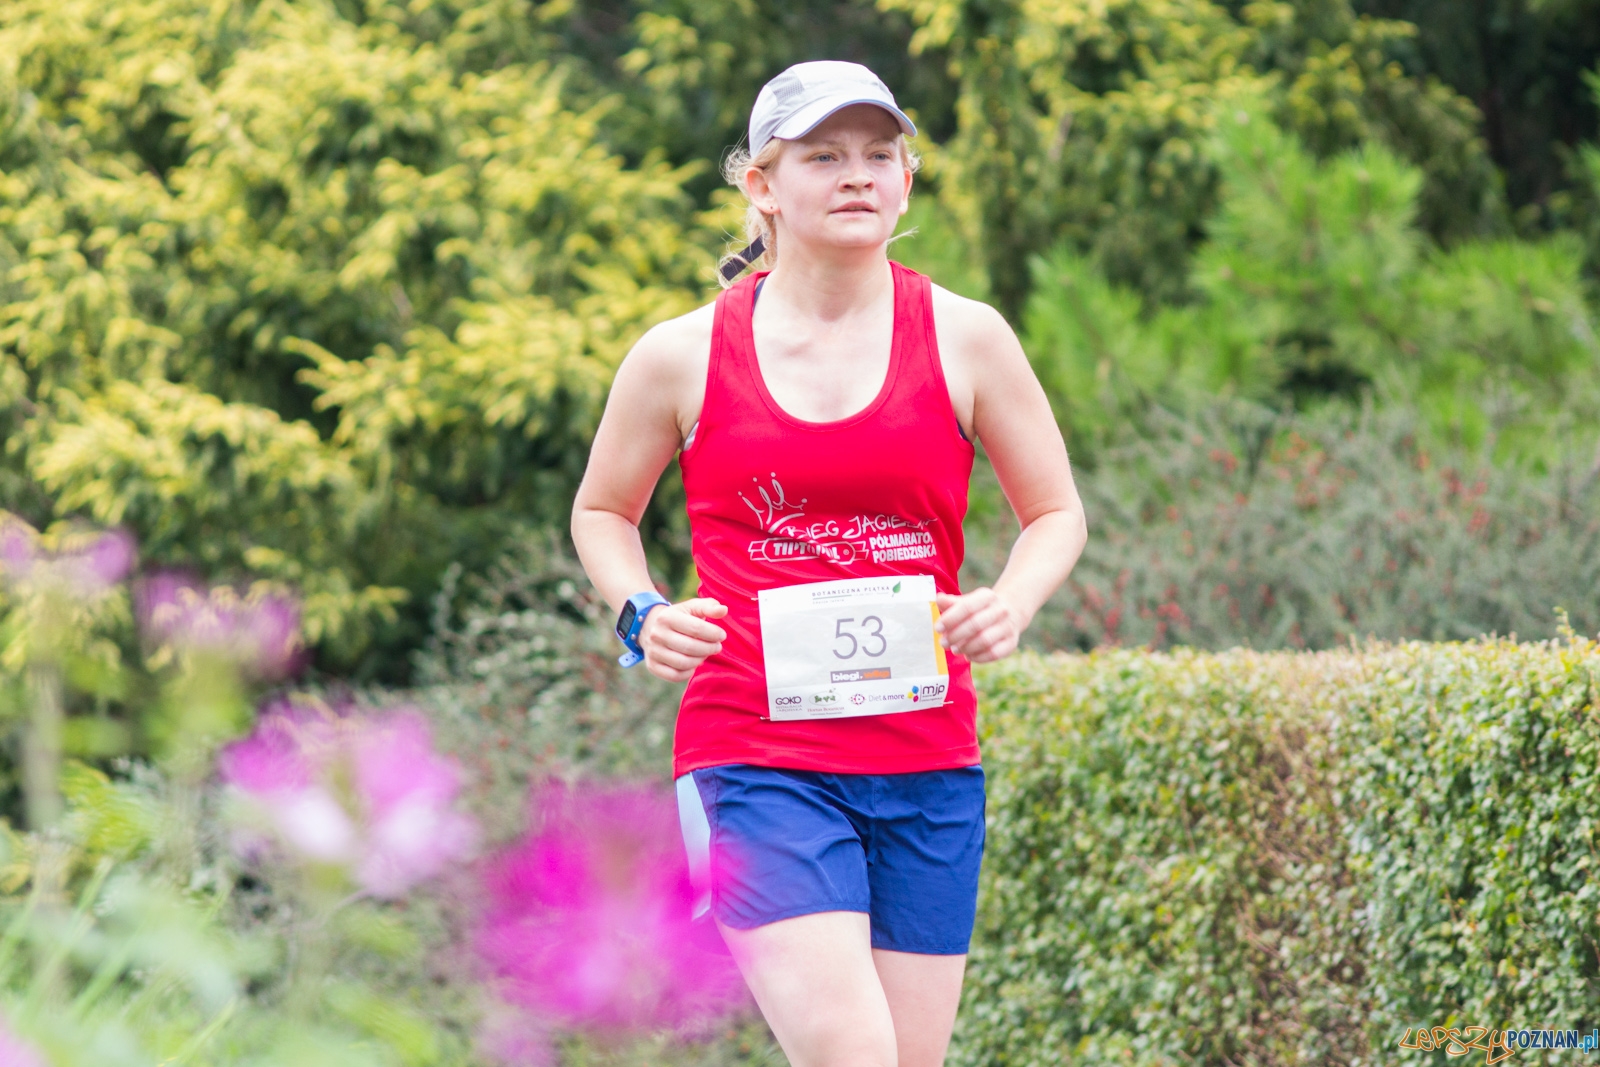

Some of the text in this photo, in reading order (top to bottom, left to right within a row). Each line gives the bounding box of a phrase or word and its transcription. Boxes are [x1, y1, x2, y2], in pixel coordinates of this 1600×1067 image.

[869, 531, 934, 550] PÓŁMARATO
[872, 544, 937, 564] POBIEDZISKA
[811, 587, 861, 597] BOTANICZNA
[864, 585, 890, 593] PIĄTKA
[832, 615, 887, 660] 53
[888, 693, 905, 701] more
[922, 683, 946, 697] mjp
[775, 695, 802, 706] GOKO
